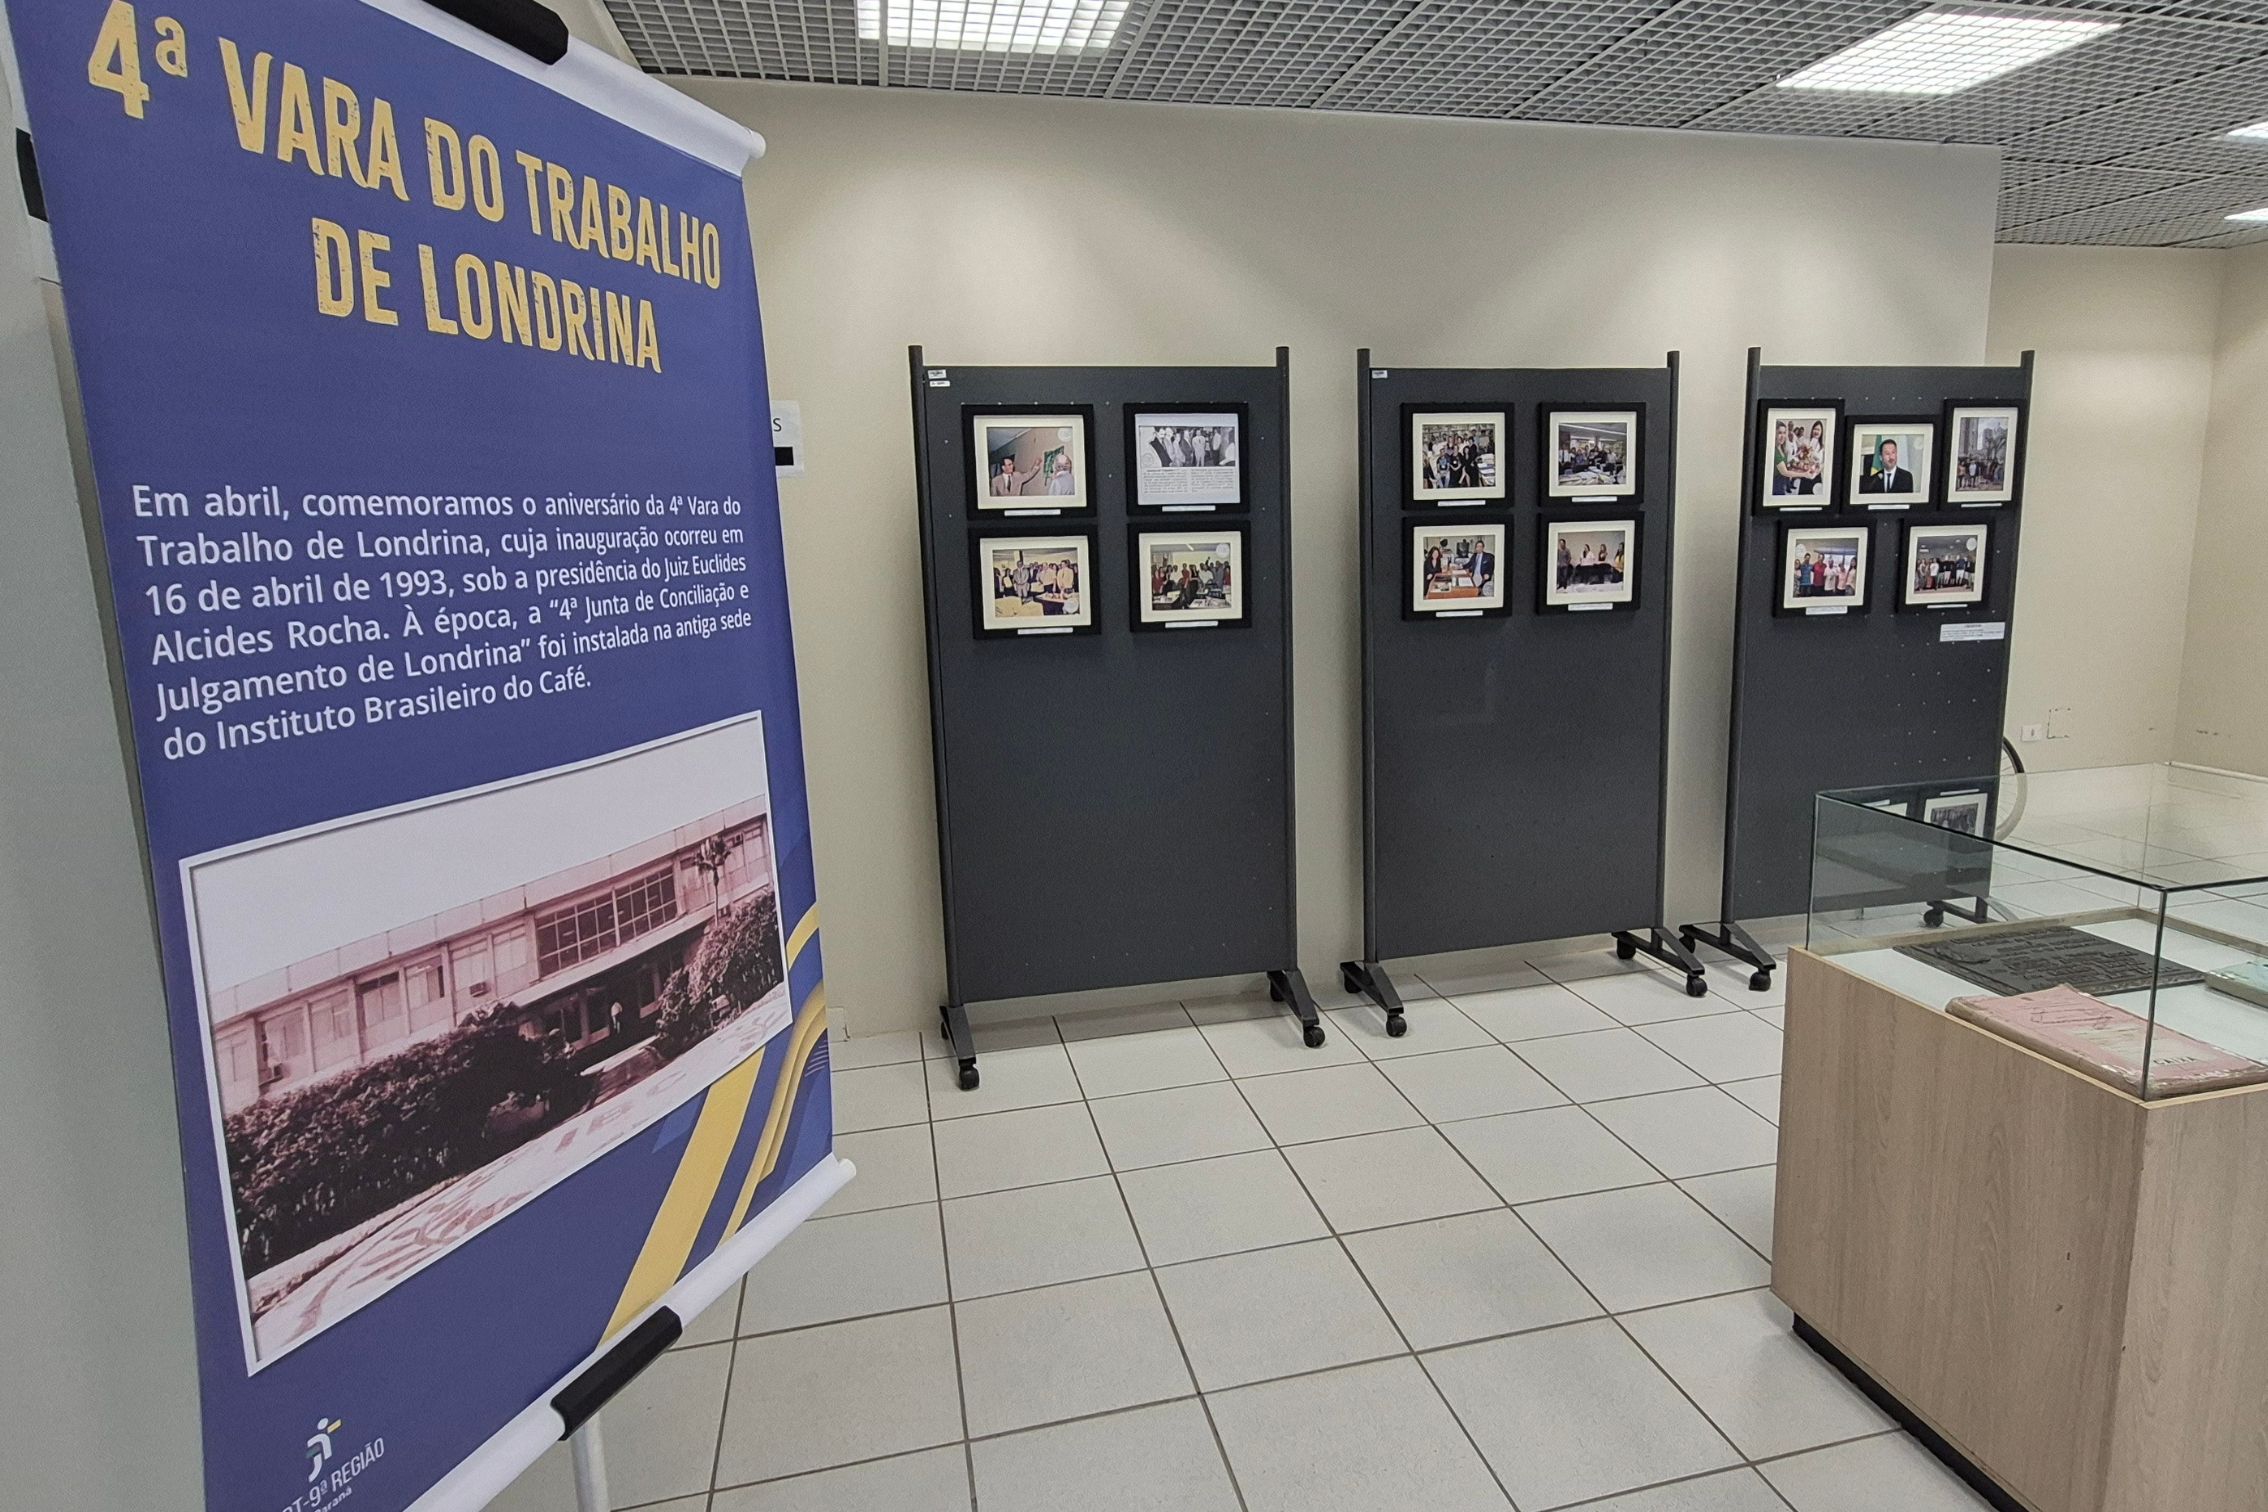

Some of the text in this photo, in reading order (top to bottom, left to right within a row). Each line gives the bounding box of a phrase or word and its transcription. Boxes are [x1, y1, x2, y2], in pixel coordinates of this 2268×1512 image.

[88, 0, 720, 289] 4ª VARA DO TRABALHO
[312, 218, 661, 373] DE LONDRINA
[133, 485, 740, 520] Em abril, comemoramos o aniversário da 4ª Vara do
[137, 527, 743, 566] Trabalho de Londrina, cuja inauguração ocorreu em
[146, 553, 746, 615] 16 de abril de 1993, sob a presidência do Juiz Euclides
[153, 626, 273, 665] Alcides
[288, 615, 389, 648] Rocha.
[404, 604, 423, 636] À
[435, 607, 517, 639] época,
[529, 606, 541, 624] a
[585, 596, 629, 623] Junta
[636, 590, 653, 611] de
[660, 583, 734, 608] Conciliação
[740, 585, 748, 598] e
[157, 665, 346, 721] Julgamento
[358, 655, 394, 682] de
[538, 633, 566, 659] foi
[573, 623, 648, 654] instalada
[654, 624, 672, 641] na
[676, 615, 717, 638] antiga
[721, 608, 751, 630] sede
[164, 665, 590, 759] do Instituto Brasileiro do Café.
[331, 1437, 384, 1492] REGIÃO
